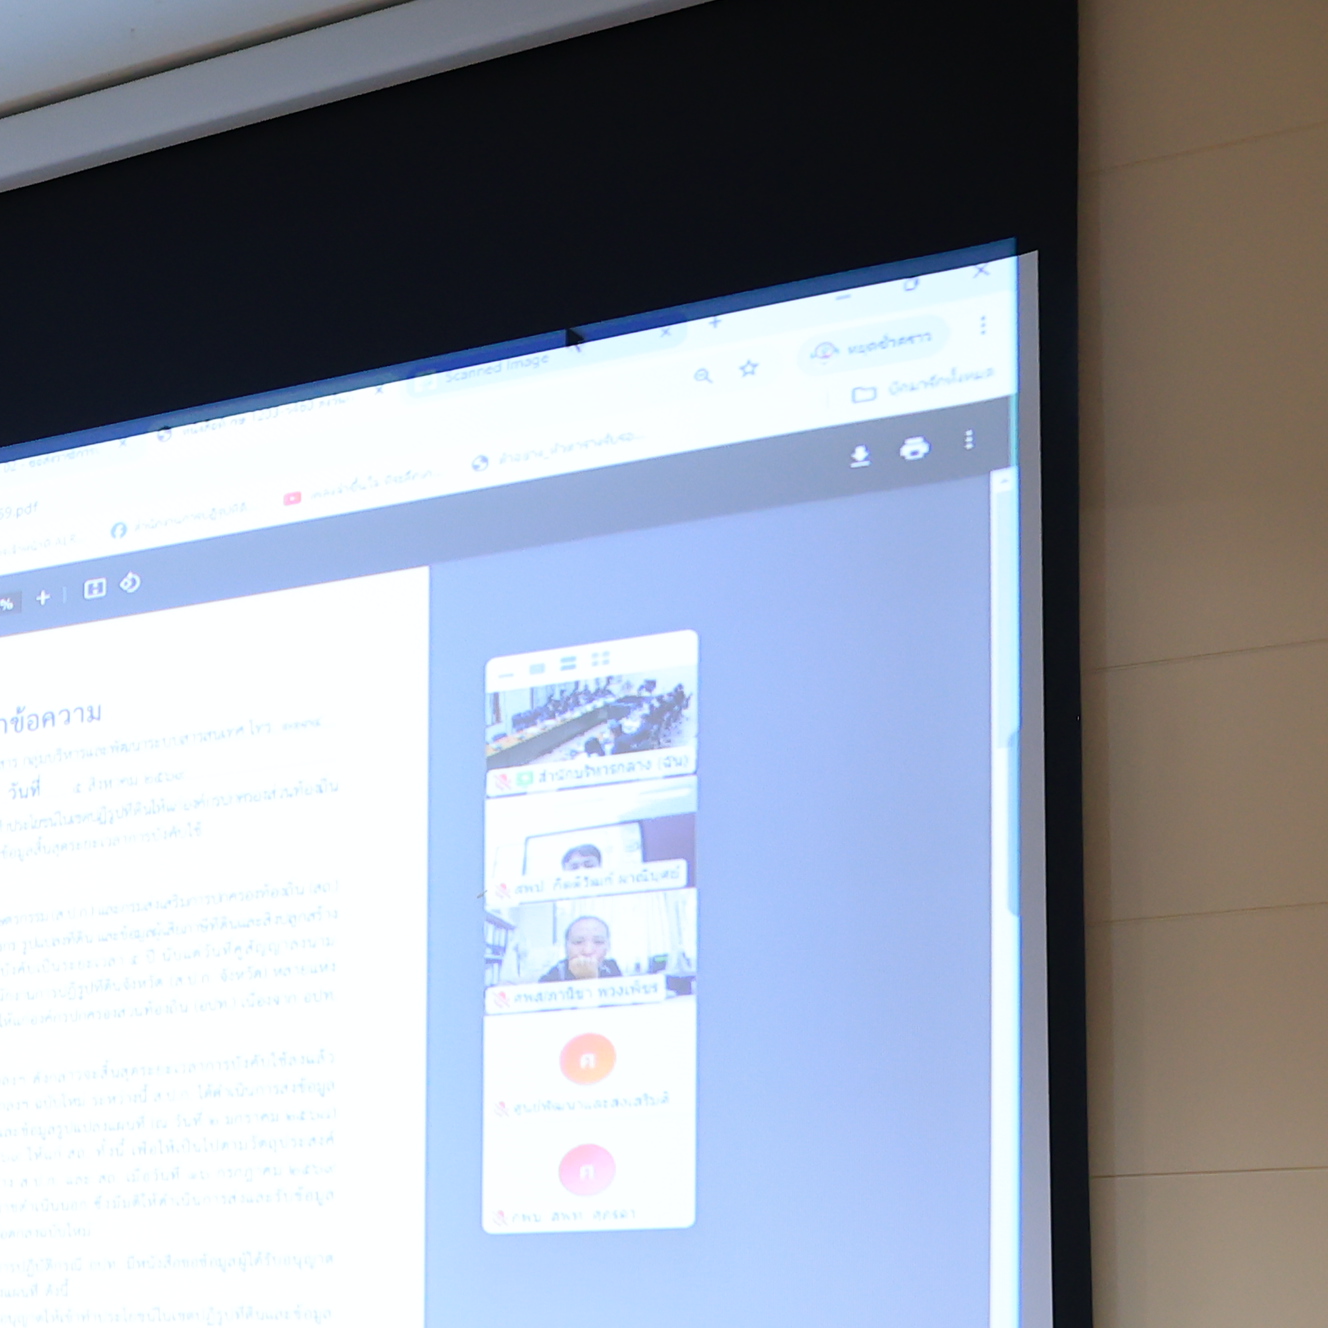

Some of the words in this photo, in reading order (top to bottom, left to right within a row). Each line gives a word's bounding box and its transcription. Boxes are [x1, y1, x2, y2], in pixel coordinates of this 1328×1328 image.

[444, 361, 503, 385] Scanned
[505, 351, 551, 375] Image
[7, 773, 42, 801] วันที่
